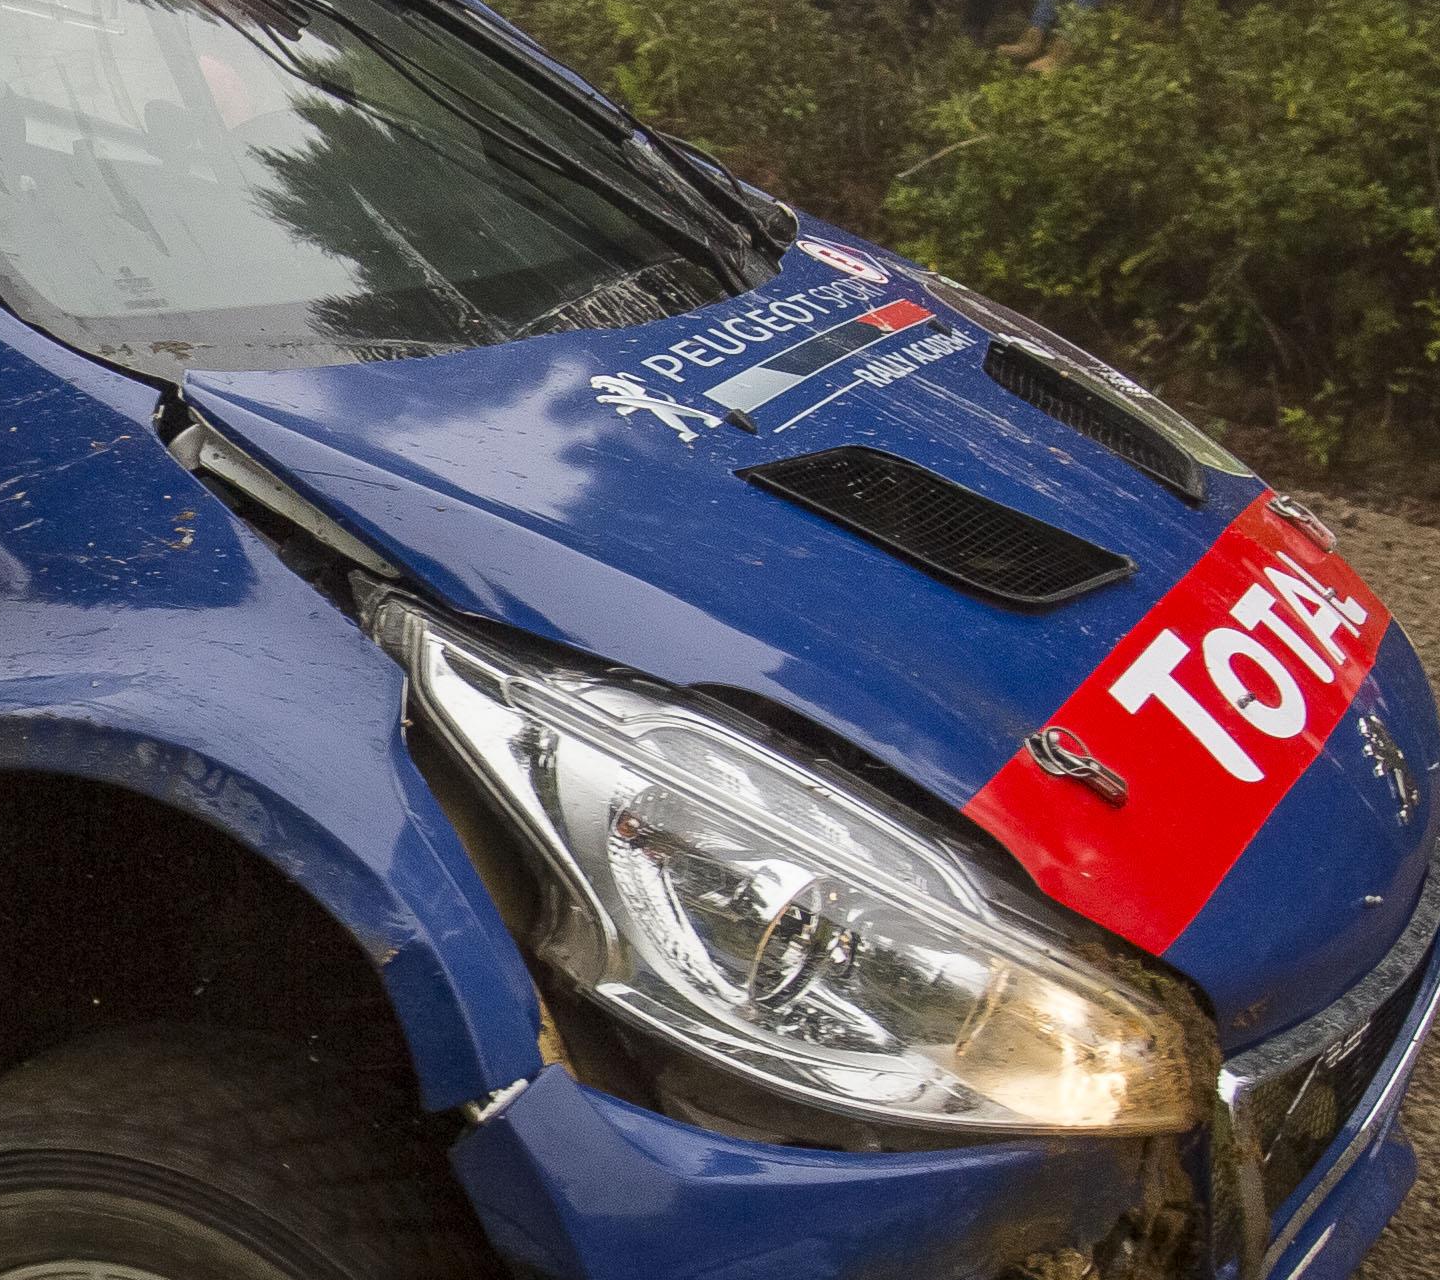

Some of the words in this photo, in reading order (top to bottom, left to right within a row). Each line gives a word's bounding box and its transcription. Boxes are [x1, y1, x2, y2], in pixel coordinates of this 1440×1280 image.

[641, 293, 830, 382] PEUGEOT
[810, 274, 890, 308] SPORT
[852, 341, 921, 387] RALLY
[905, 330, 977, 367] ACADEMY
[1108, 551, 1367, 782] TOTAL
